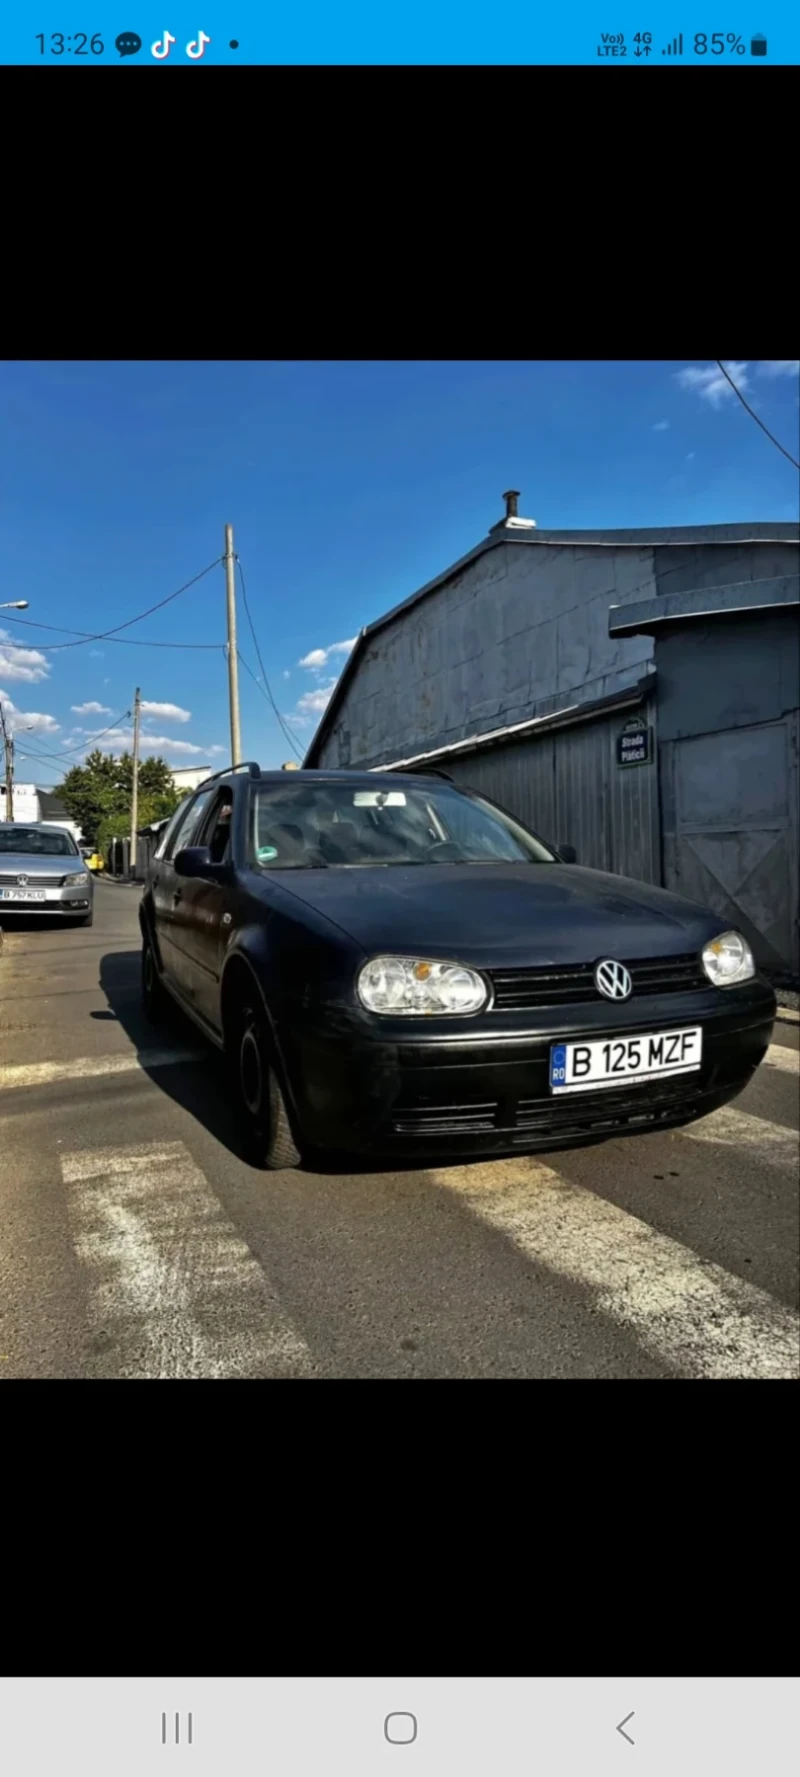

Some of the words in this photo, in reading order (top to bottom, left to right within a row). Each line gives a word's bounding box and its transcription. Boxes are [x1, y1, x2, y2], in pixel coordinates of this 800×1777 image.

[622, 734, 643, 748] Strada
[596, 960, 632, 999] VW
[572, 1047, 592, 1077] B
[602, 1039, 641, 1073] 125
[648, 1031, 698, 1067] MZF
[552, 1068, 565, 1080] RO
